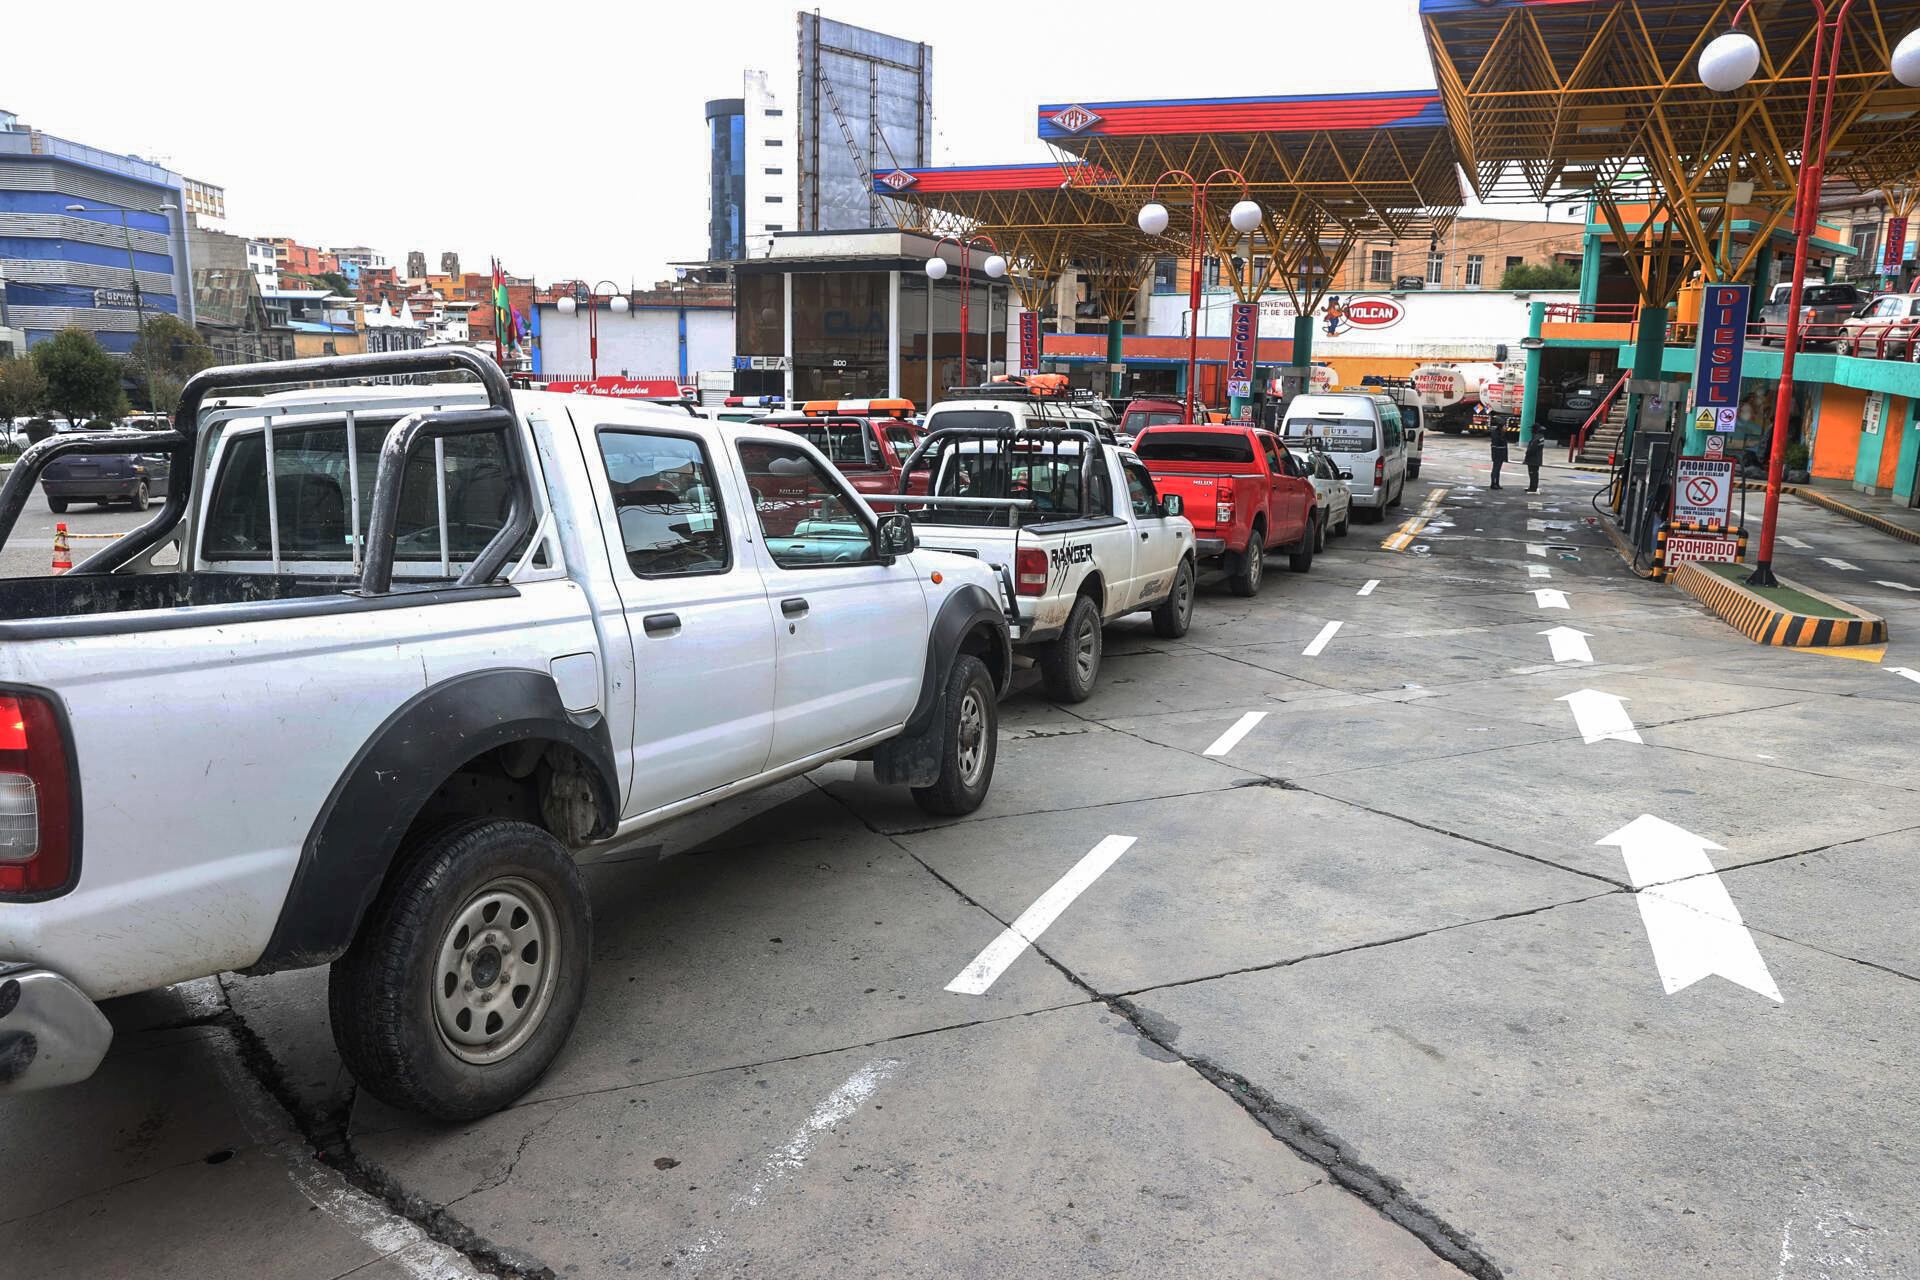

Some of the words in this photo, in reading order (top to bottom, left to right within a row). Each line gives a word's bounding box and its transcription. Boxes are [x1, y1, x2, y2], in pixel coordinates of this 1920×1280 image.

[1060, 110, 1089, 128] YPFB
[887, 174, 908, 187] YPFB
[1349, 307, 1394, 319] VOLCAN
[1022, 313, 1034, 367] GASOLINA
[1231, 306, 1251, 379] GASOLINA
[1708, 289, 1740, 402] DIESEL
[1321, 438, 1333, 447] 19
[1680, 461, 1730, 472] PROHIBIDO
[1050, 543, 1095, 568] RANGER
[1668, 540, 1735, 556] PROHIBIDO
